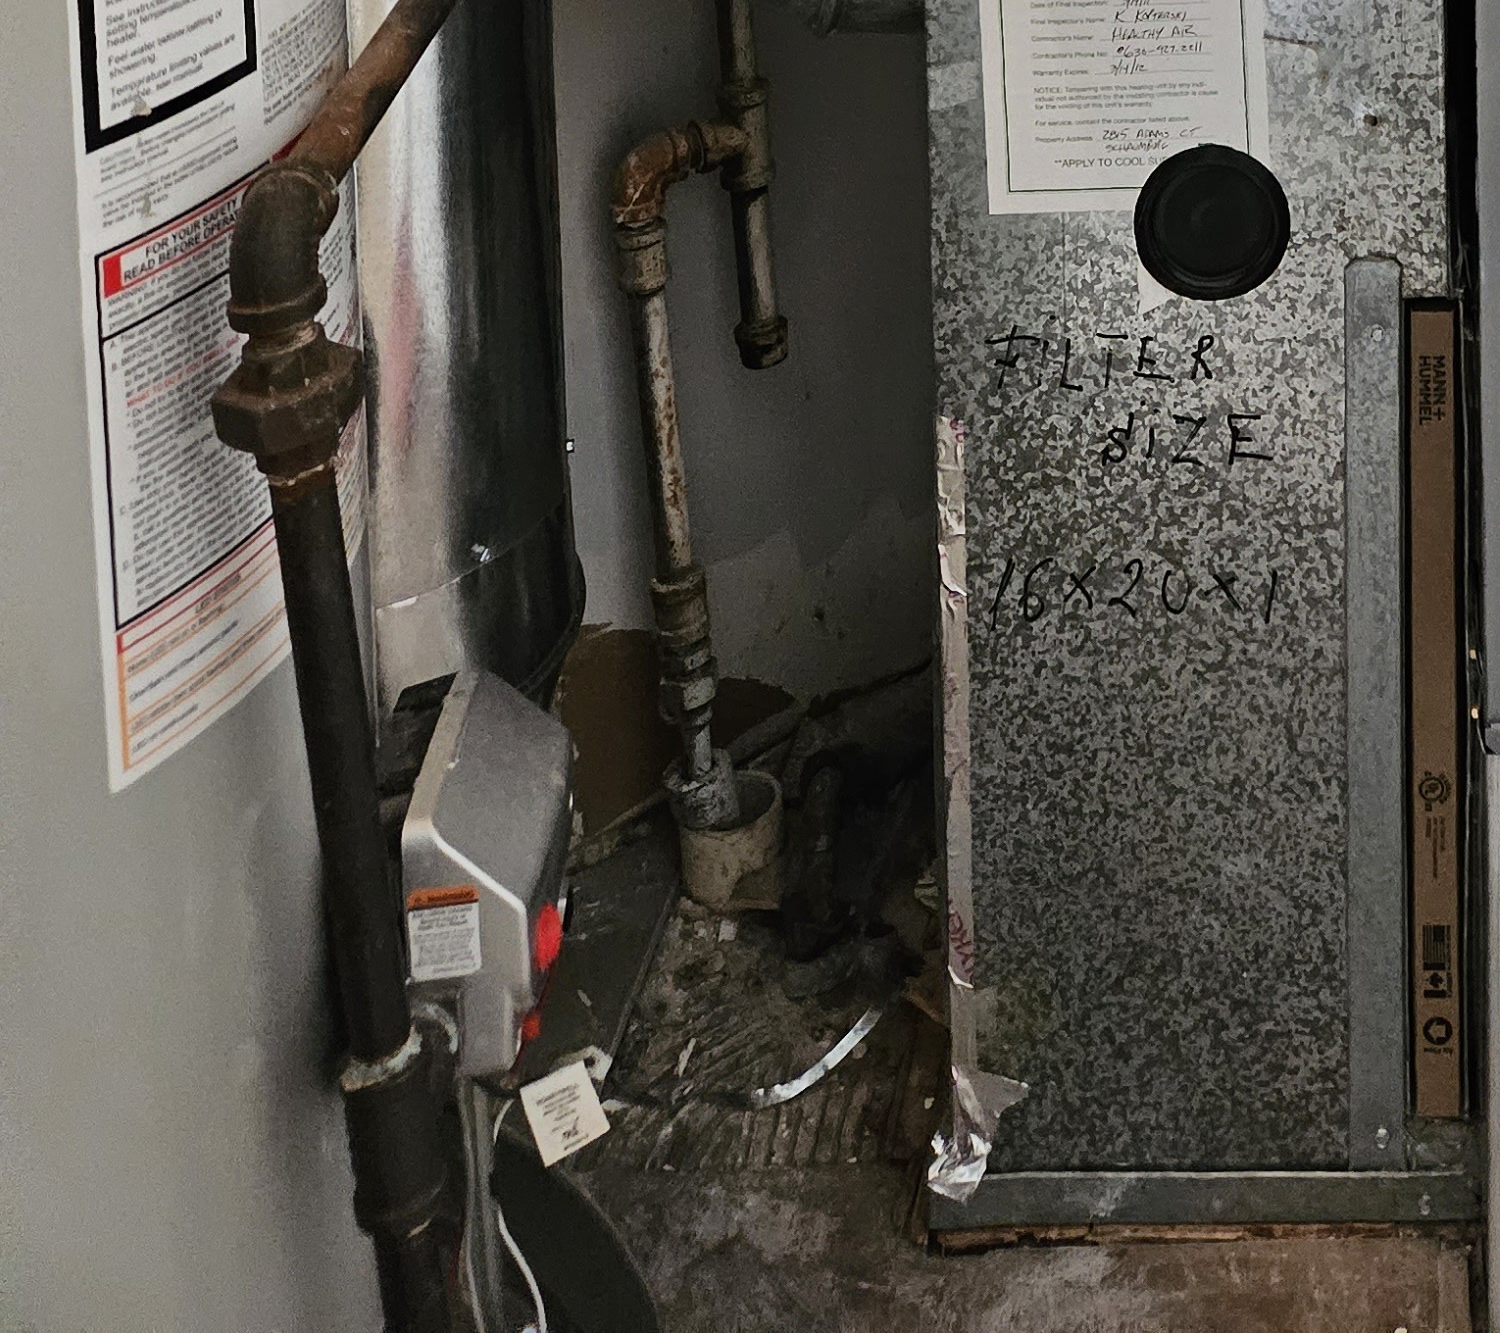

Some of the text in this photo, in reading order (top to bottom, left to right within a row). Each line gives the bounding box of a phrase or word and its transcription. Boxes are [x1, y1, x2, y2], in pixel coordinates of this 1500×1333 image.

[1098, 158, 1113, 167] TO
[1114, 157, 1145, 167] COOL
[123, 257, 156, 281] READ
[158, 234, 201, 260] BEFORE
[145, 196, 238, 258] FOR YOUR SAFETY
[984, 323, 1214, 392] FILTER
[1432, 355, 1446, 422] MANN+
[1418, 355, 1432, 426] HUMMEL
[1101, 408, 1274, 466] SIZE
